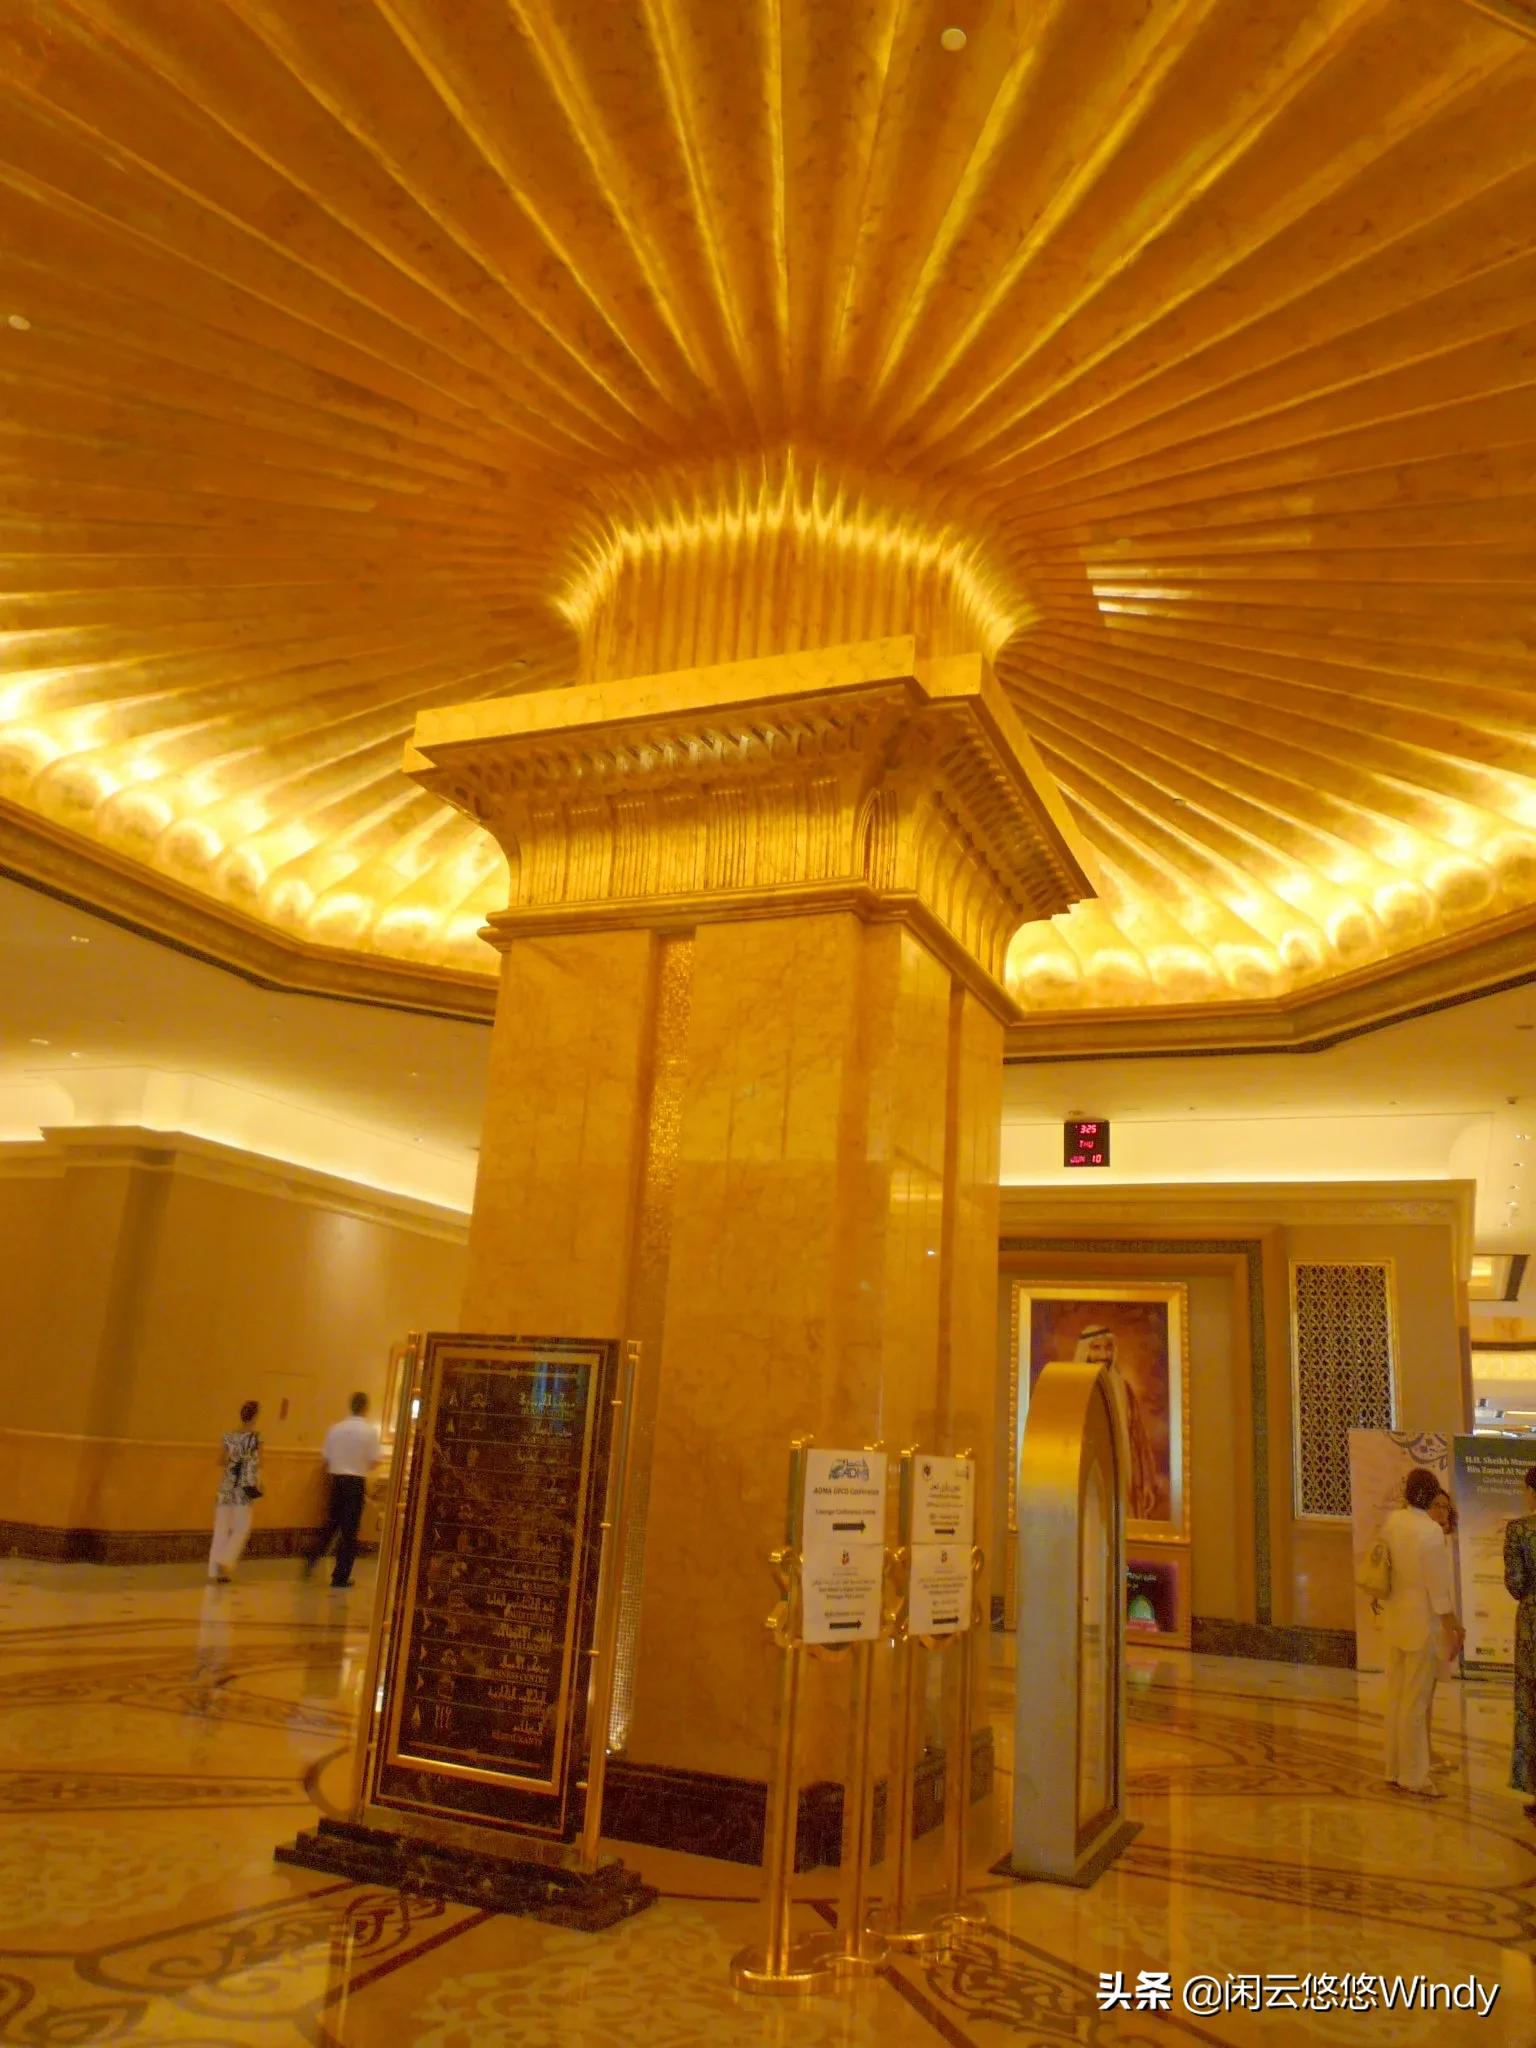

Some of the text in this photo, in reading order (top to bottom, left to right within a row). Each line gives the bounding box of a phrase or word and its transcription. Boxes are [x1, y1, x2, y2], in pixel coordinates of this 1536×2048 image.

[1079, 1140, 1094, 1149] THU
[1092, 1154, 1102, 1164] 10
[1482, 1457, 1507, 1465] Sheikh
